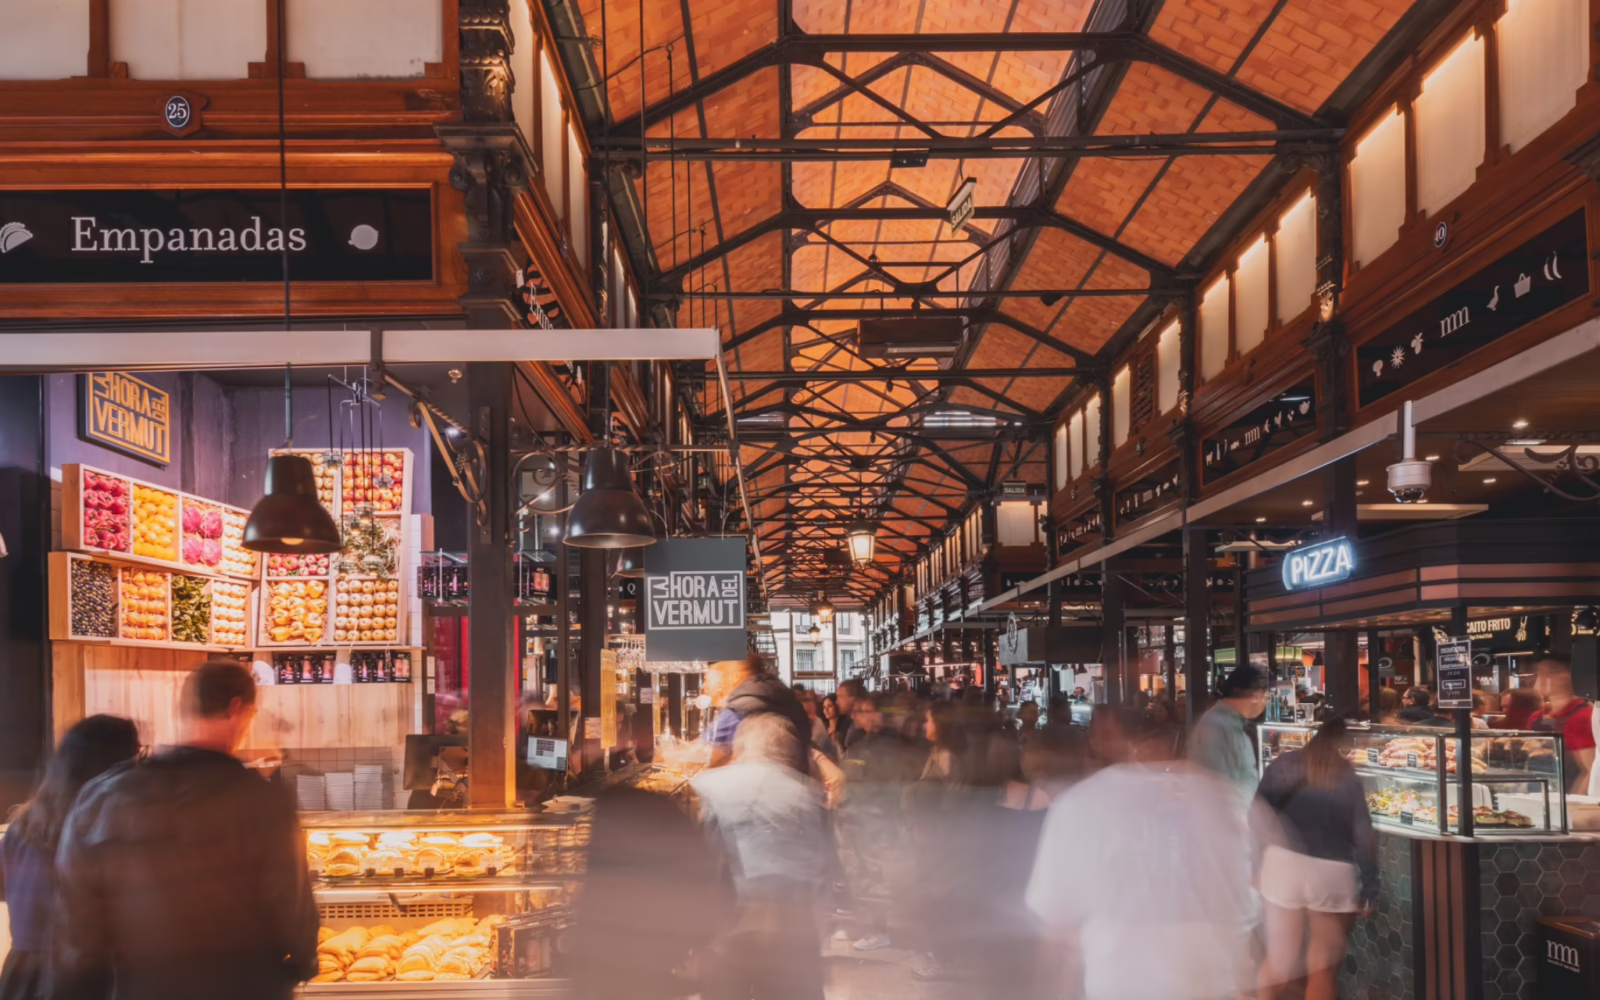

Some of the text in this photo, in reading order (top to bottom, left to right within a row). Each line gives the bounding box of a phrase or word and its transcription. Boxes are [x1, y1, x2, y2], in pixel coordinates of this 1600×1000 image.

[168, 103, 187, 119] 25
[952, 196, 972, 228] SALIDA
[71, 216, 307, 264] Empanadas
[109, 372, 152, 418] HORA
[151, 396, 167, 426] DEL
[94, 396, 167, 454] VERMUT
[1291, 544, 1354, 585] PIZZA
[653, 575, 738, 599] LA HORA DEL
[653, 599, 738, 625] VERMUT
[1487, 617, 1511, 631] FRITO
